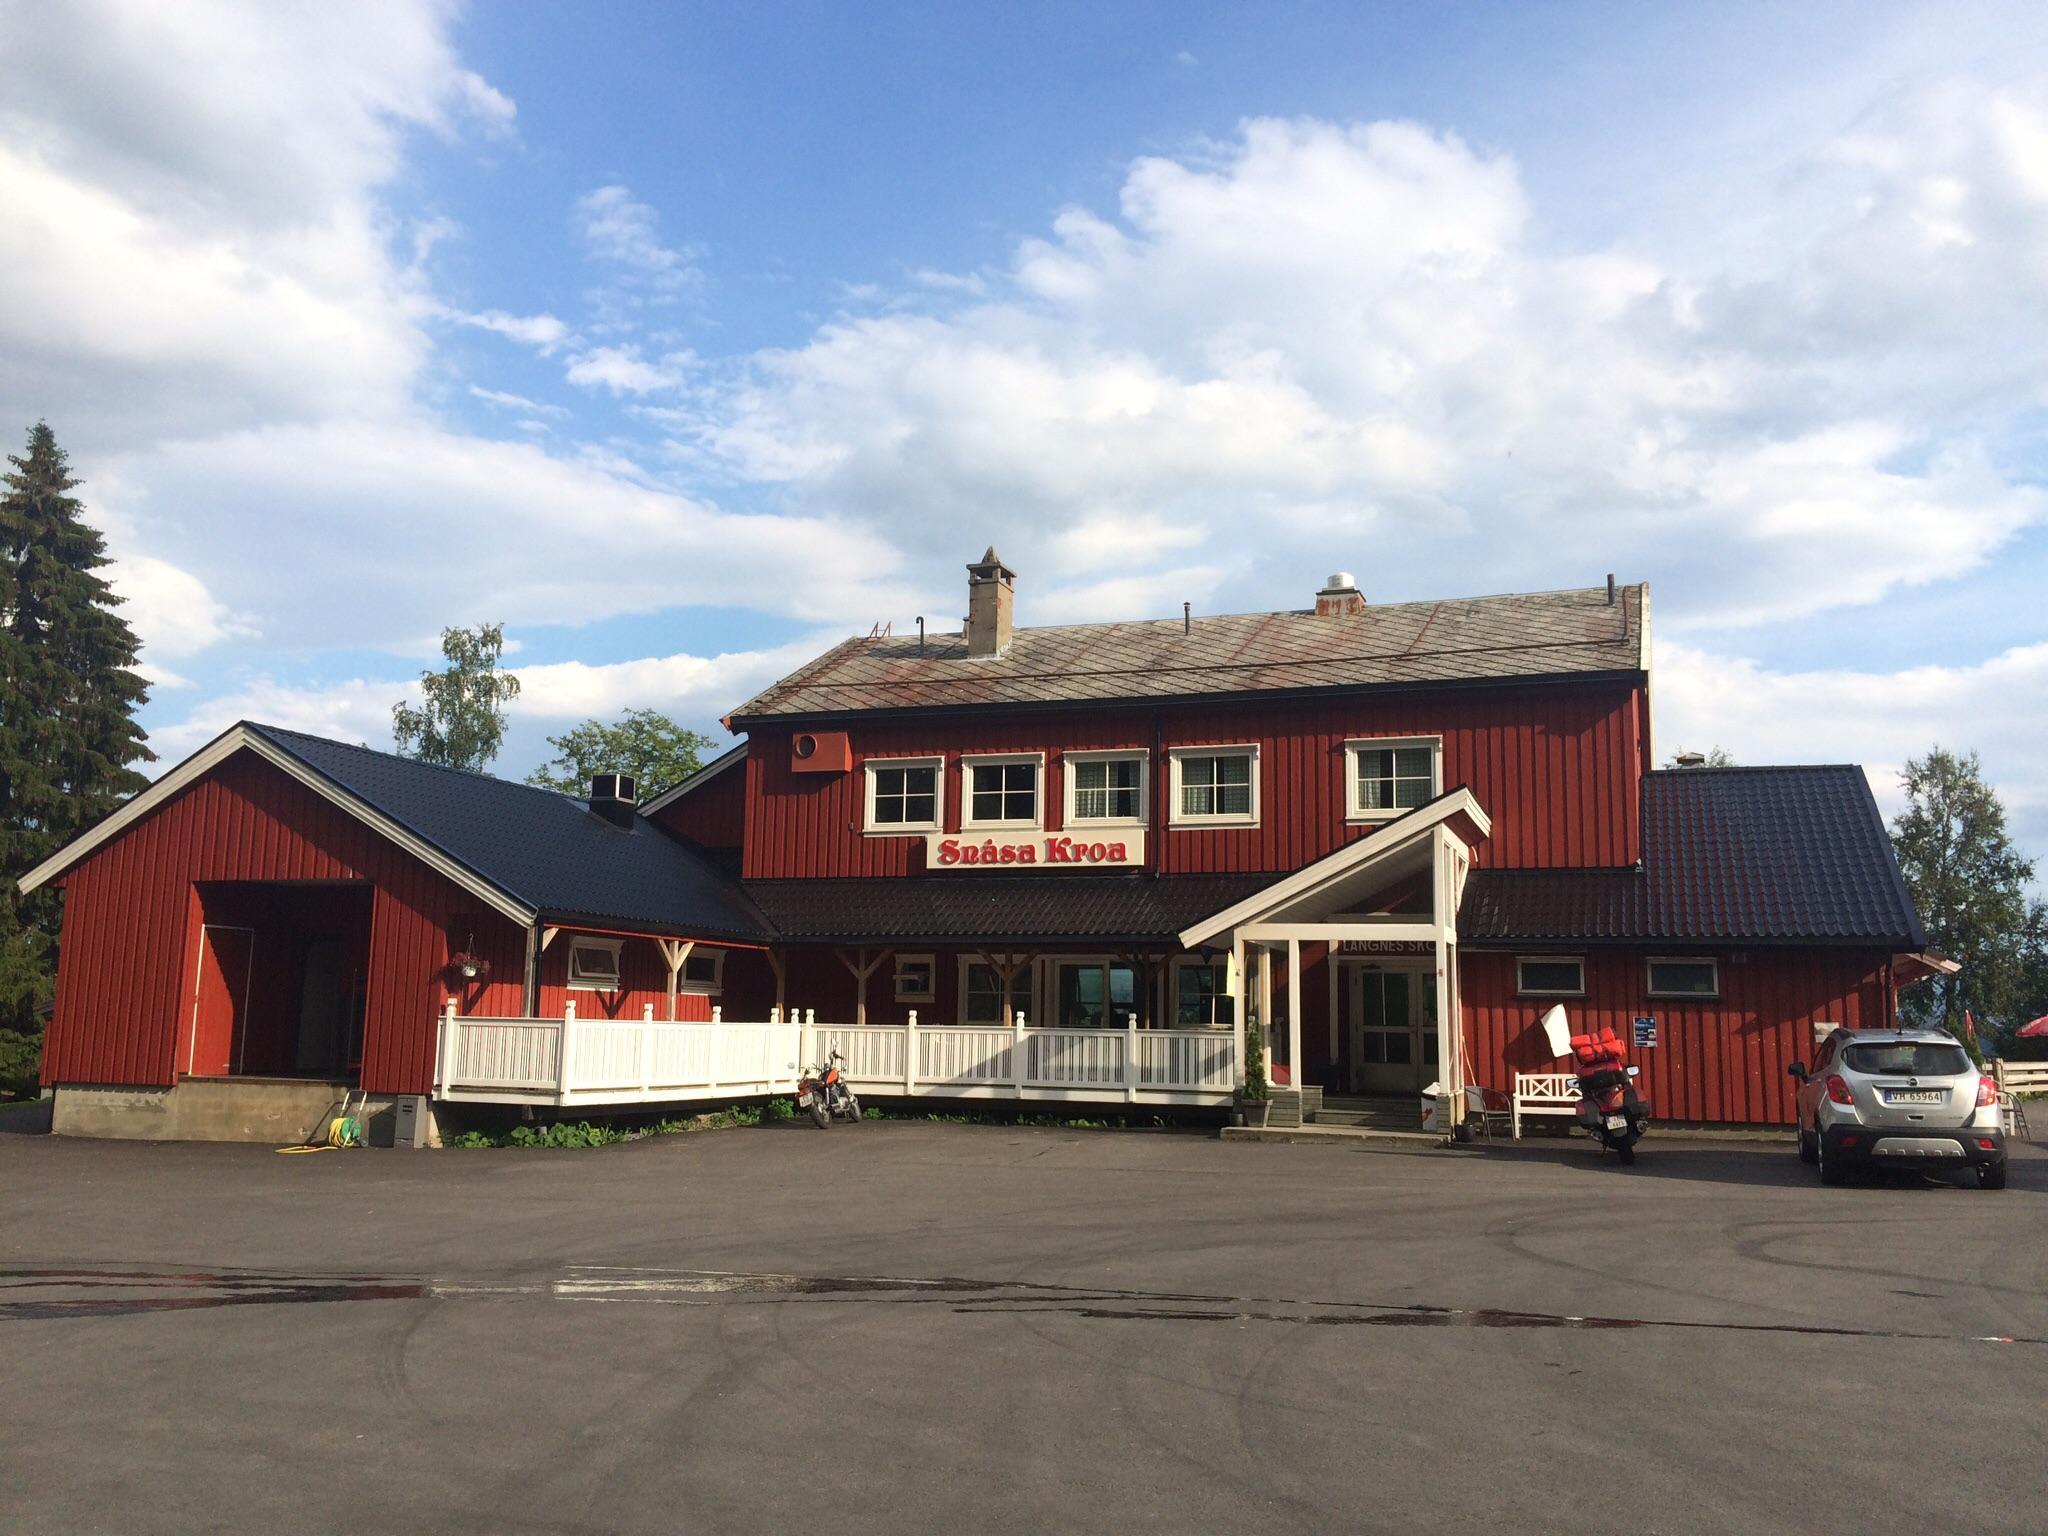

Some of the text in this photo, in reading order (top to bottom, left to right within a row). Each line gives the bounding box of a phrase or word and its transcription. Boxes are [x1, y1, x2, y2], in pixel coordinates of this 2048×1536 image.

[1044, 837, 1127, 863] Kroa
[1893, 1092, 1939, 1101] VH 65964
